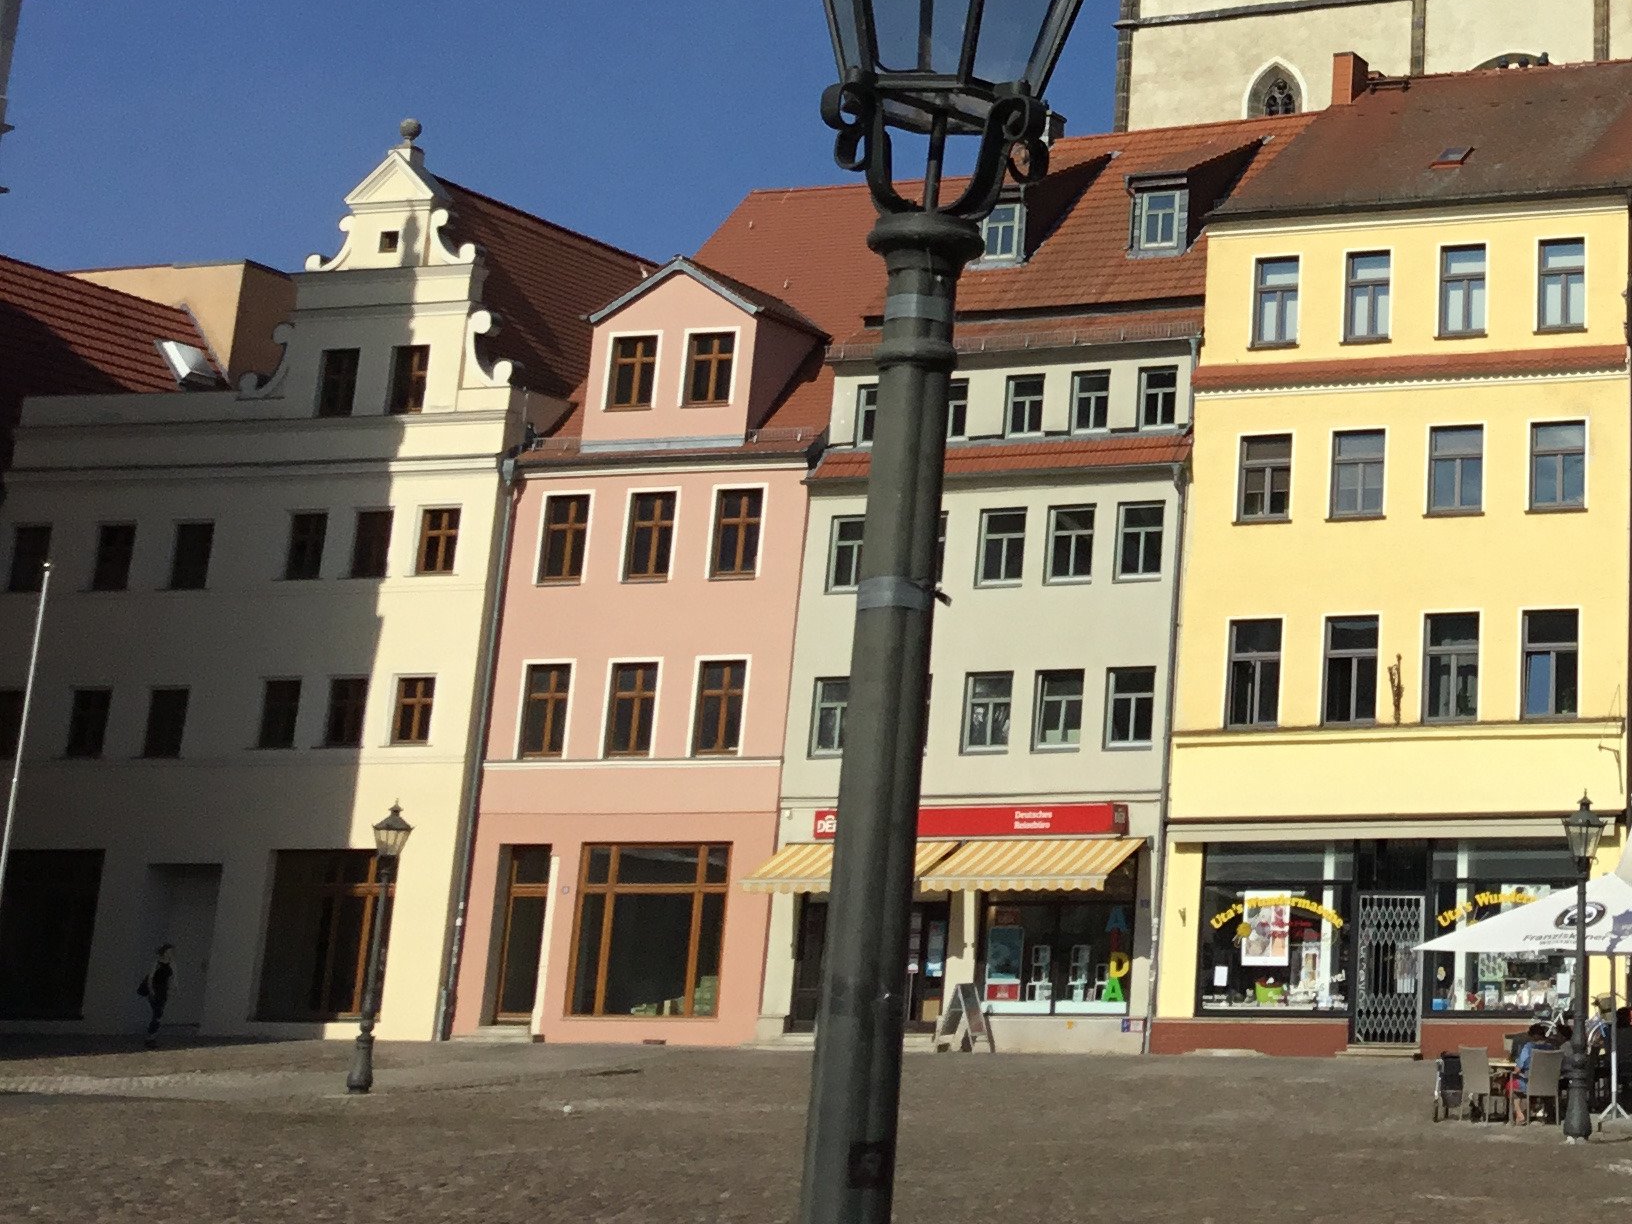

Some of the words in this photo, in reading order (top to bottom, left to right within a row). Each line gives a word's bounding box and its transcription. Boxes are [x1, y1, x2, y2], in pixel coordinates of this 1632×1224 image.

[1210, 903, 1244, 929] Uta's
[1522, 931, 1607, 941] Franziskner
[1101, 905, 1130, 1002] AIDA
